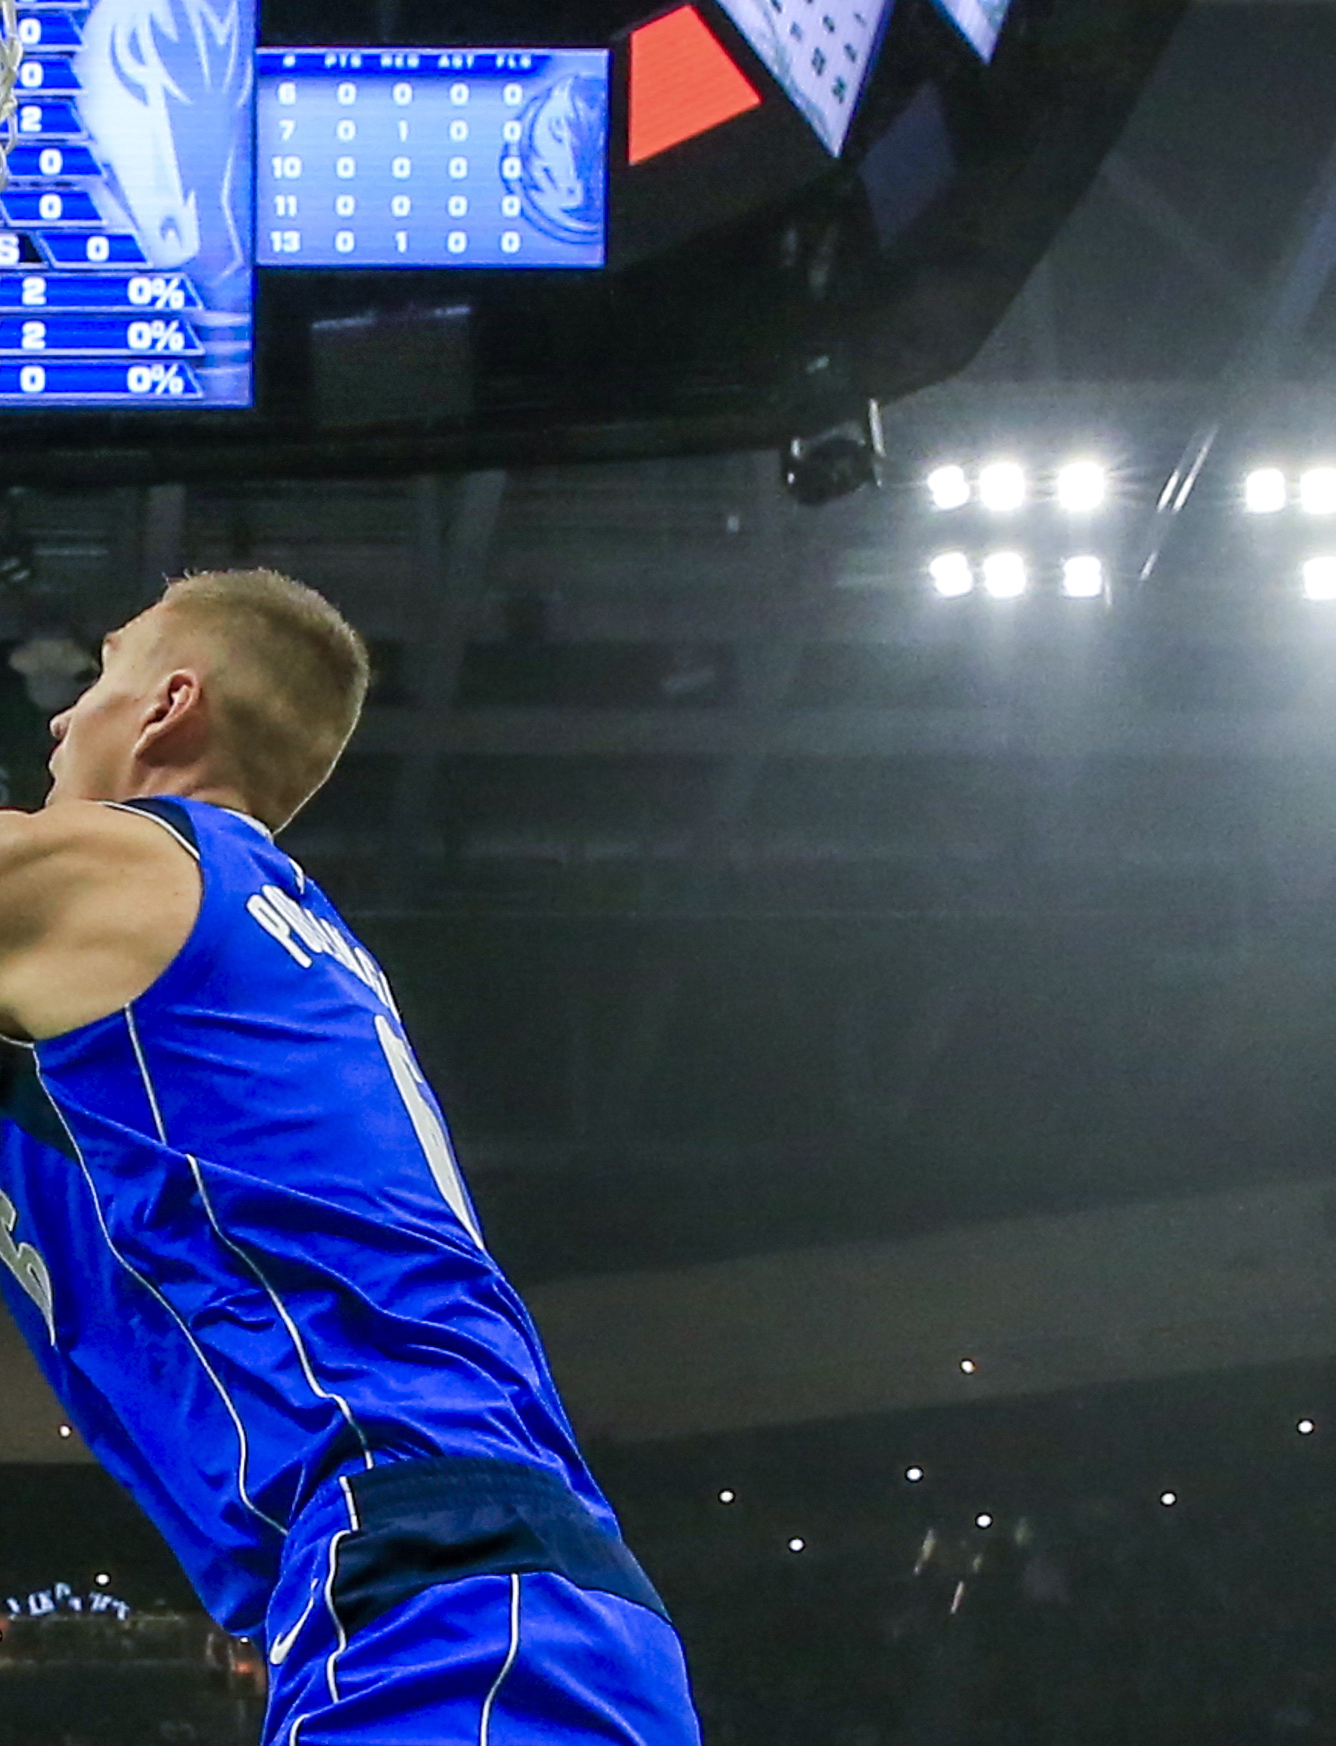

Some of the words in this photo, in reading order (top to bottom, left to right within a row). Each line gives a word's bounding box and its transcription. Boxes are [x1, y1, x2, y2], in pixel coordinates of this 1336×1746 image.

[15, 18, 45, 48] 0
[18, 61, 44, 88] 0
[333, 83, 357, 109] 0
[392, 82, 415, 109] 0
[449, 83, 470, 107] 0
[503, 83, 524, 107] 0
[20, 105, 42, 133] 2
[279, 119, 296, 140] 7
[336, 120, 356, 141] 0
[399, 120, 408, 142] 1
[450, 120, 469, 141] 0
[502, 120, 523, 143] 0
[39, 148, 63, 176] 0
[272, 156, 302, 178] 10
[336, 156, 355, 178] 0
[392, 156, 411, 178] 0
[449, 156, 468, 178] 0
[502, 155, 523, 180] 0
[38, 194, 62, 219] 0
[274, 195, 297, 217] 11
[336, 195, 355, 216] 0
[391, 195, 411, 216] 0
[448, 195, 468, 216] 0
[501, 195, 522, 218] 0
[86, 235, 110, 263] 0
[271, 230, 301, 252] 13
[335, 230, 355, 252] 0
[395, 231, 407, 253] 1
[447, 231, 467, 253] 0
[501, 231, 521, 253] 0
[22, 276, 46, 305] 2
[124, 276, 190, 311] 0%
[21, 323, 46, 351] 2
[124, 320, 190, 355] 0%
[20, 365, 46, 394] 0
[127, 363, 184, 399] 0%
